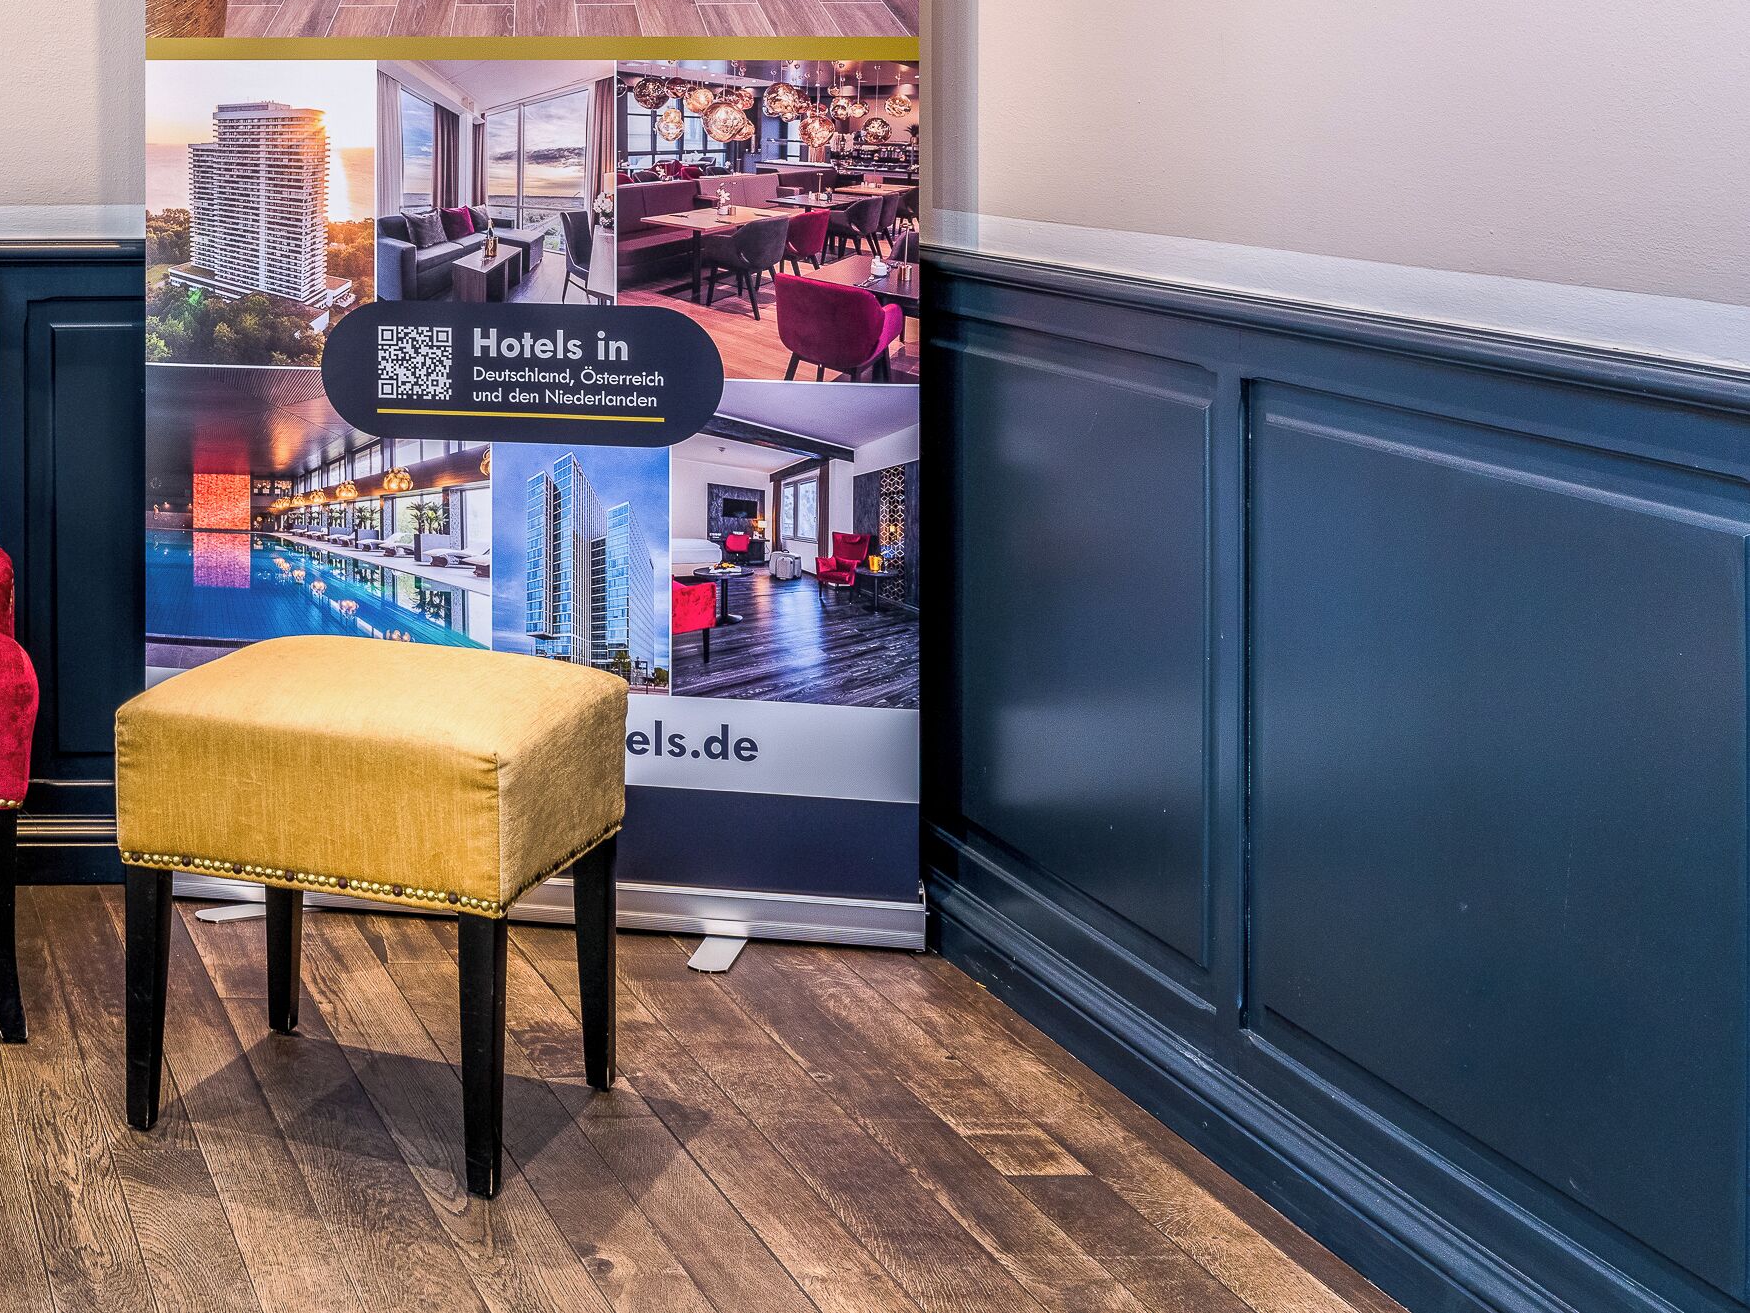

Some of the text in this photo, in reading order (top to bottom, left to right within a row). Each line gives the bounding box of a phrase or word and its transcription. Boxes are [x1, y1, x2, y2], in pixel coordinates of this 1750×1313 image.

[473, 327, 629, 361] Hotels in
[473, 365, 665, 387] Deutschland, Österreich
[472, 387, 658, 407] und den Niederlanden
[625, 719, 759, 762] els.de
